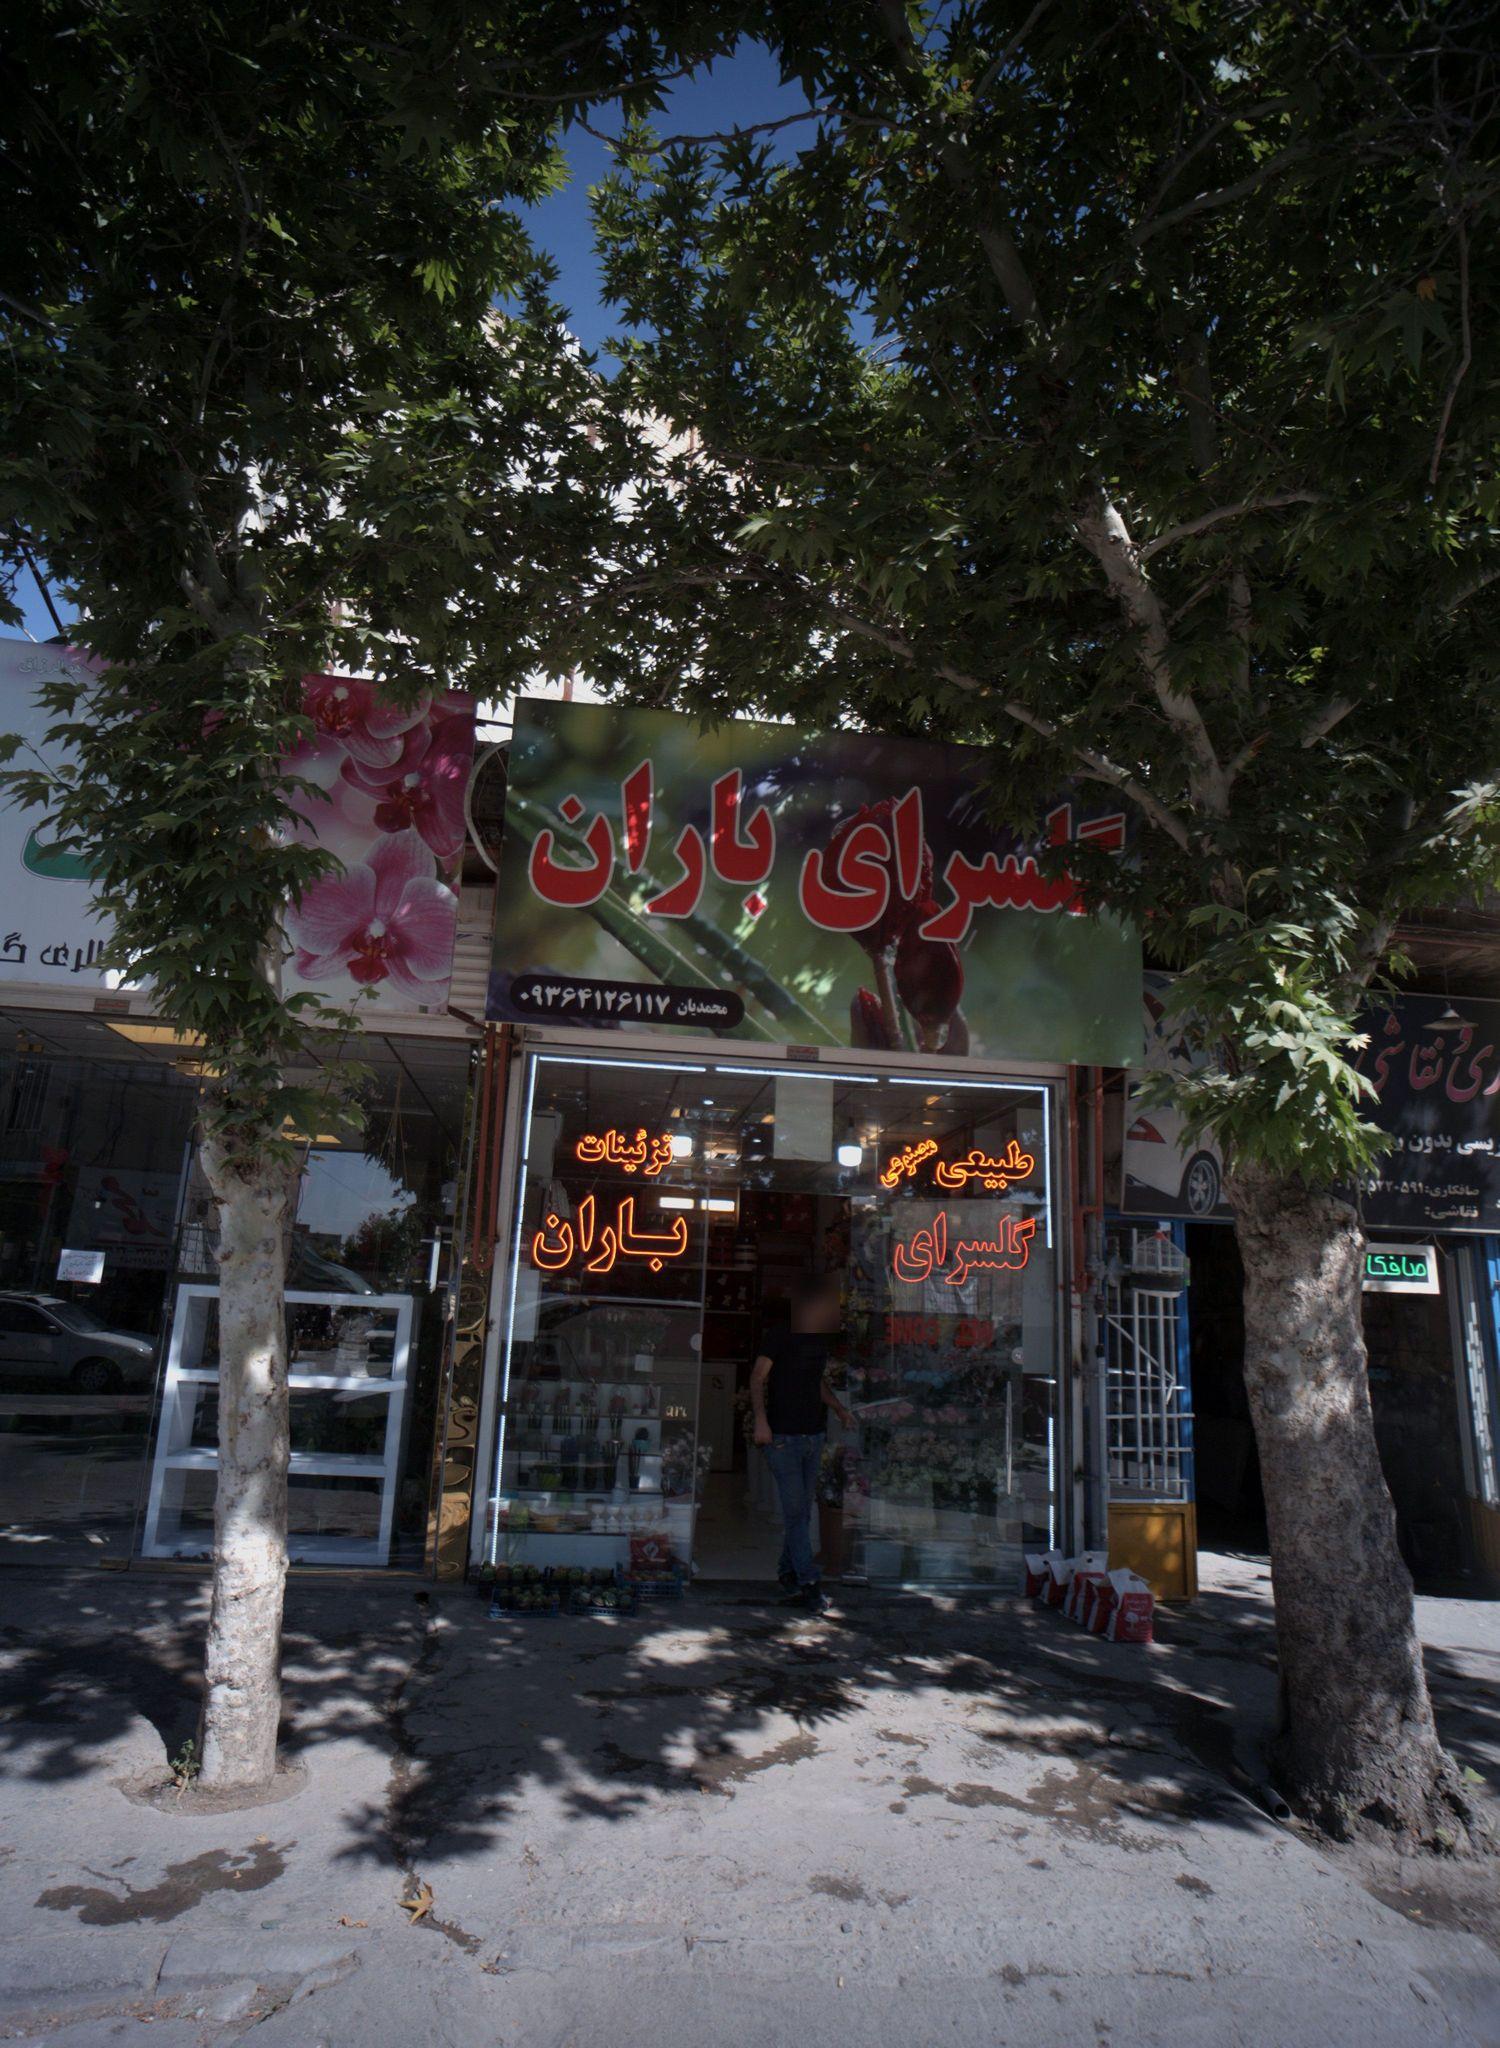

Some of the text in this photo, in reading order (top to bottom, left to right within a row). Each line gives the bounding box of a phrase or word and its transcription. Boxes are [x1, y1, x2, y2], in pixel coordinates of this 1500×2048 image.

[528, 757, 777, 920] باران
[519, 984, 729, 1018] ۰۹۳۶۴۱۲۶۱۱۷ محمدیان
[575, 1128, 674, 1175] تزئینات
[879, 1139, 1035, 1190] طبیعی مصنوعی
[1407, 1133, 1453, 1154] بدون
[532, 1193, 689, 1273] باران
[893, 1210, 1037, 1286] گلسرای
[1366, 1253, 1428, 1279] صافکا
